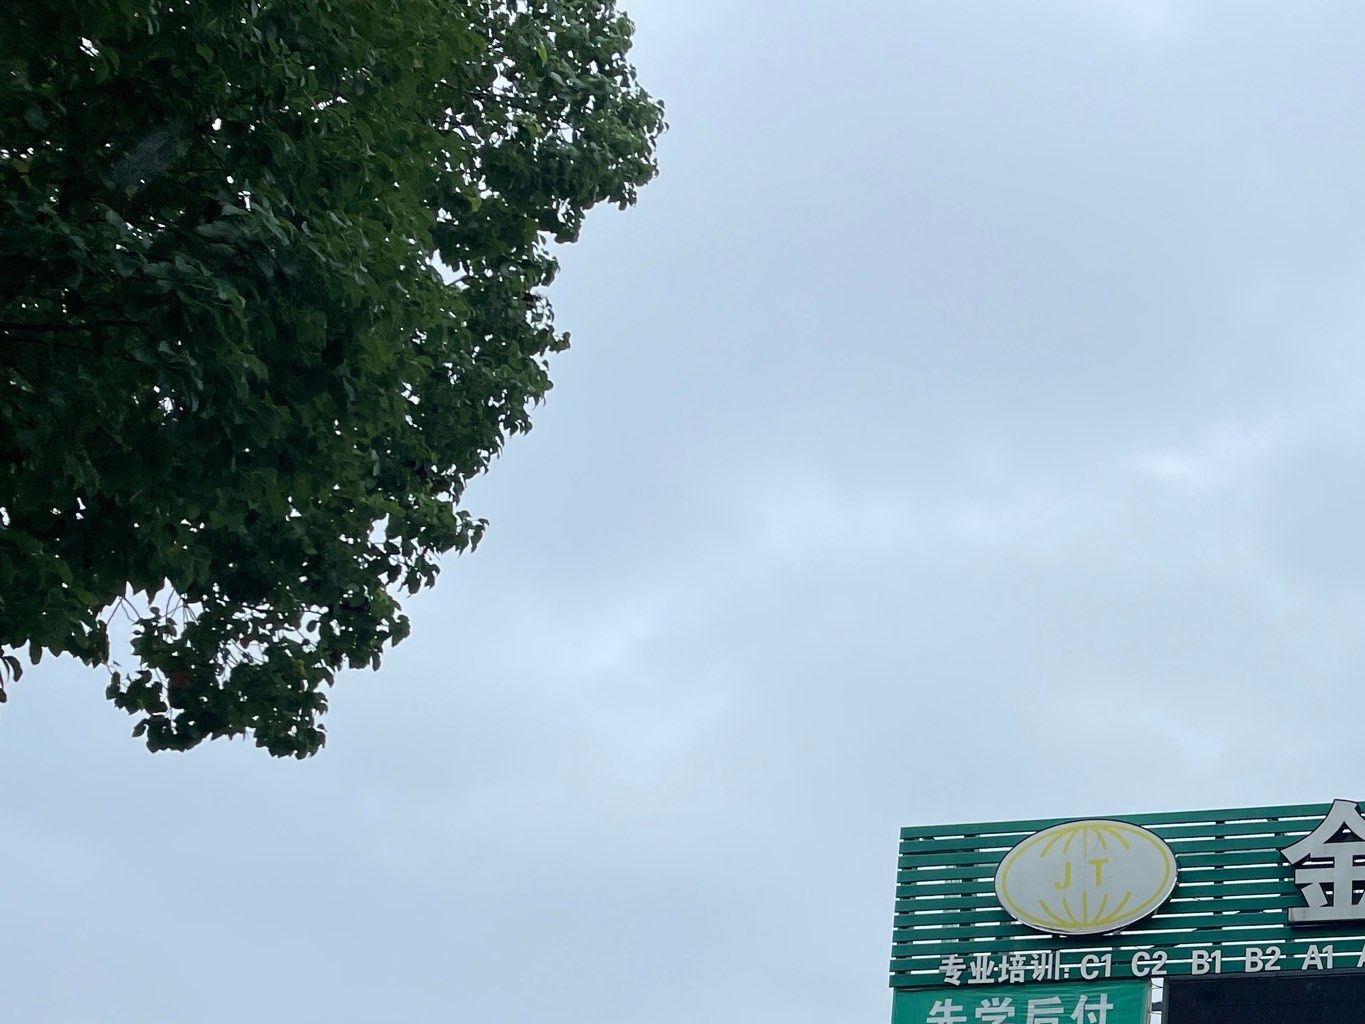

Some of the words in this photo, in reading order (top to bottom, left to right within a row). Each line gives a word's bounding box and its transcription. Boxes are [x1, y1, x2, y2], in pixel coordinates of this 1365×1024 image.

[1080, 956, 1112, 980] C1
[1131, 951, 1168, 976] C2
[1191, 949, 1222, 974] B1
[1244, 946, 1281, 972] B2
[1302, 944, 1334, 969] A1
